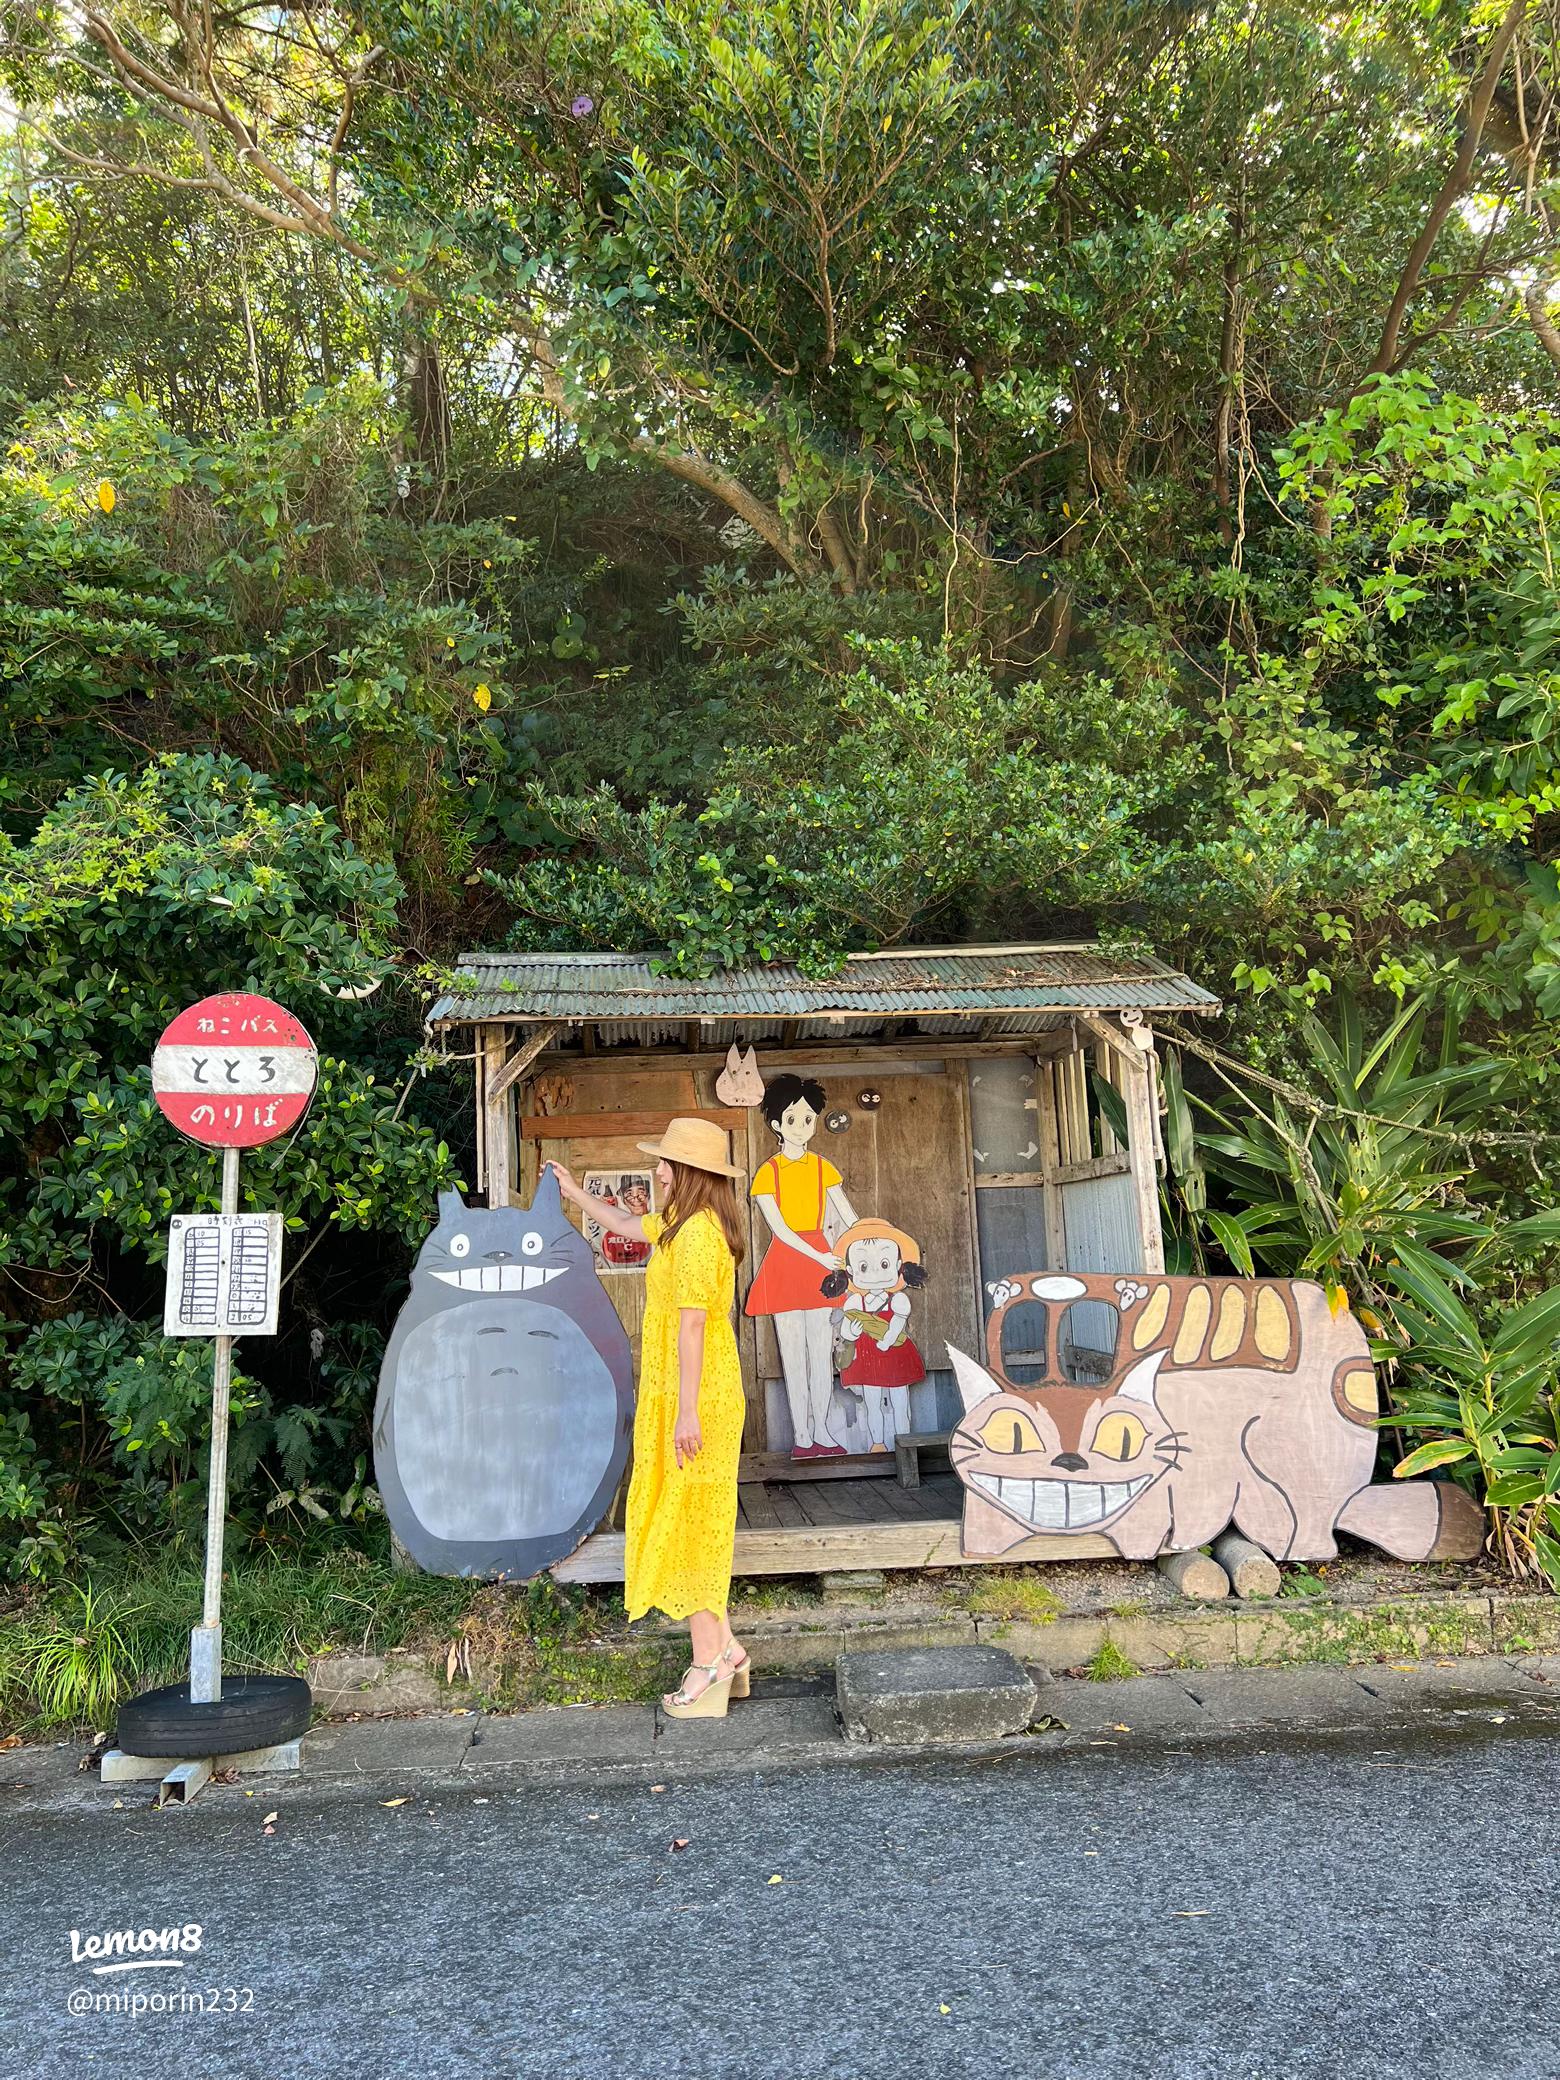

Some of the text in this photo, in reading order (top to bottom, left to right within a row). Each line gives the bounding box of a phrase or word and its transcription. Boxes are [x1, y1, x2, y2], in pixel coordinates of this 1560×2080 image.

[197, 1015, 278, 1034] ねこバス
[191, 1056, 276, 1084] ととろ
[190, 1098, 284, 1129] のりば
[242, 1313, 253, 1321] 05
